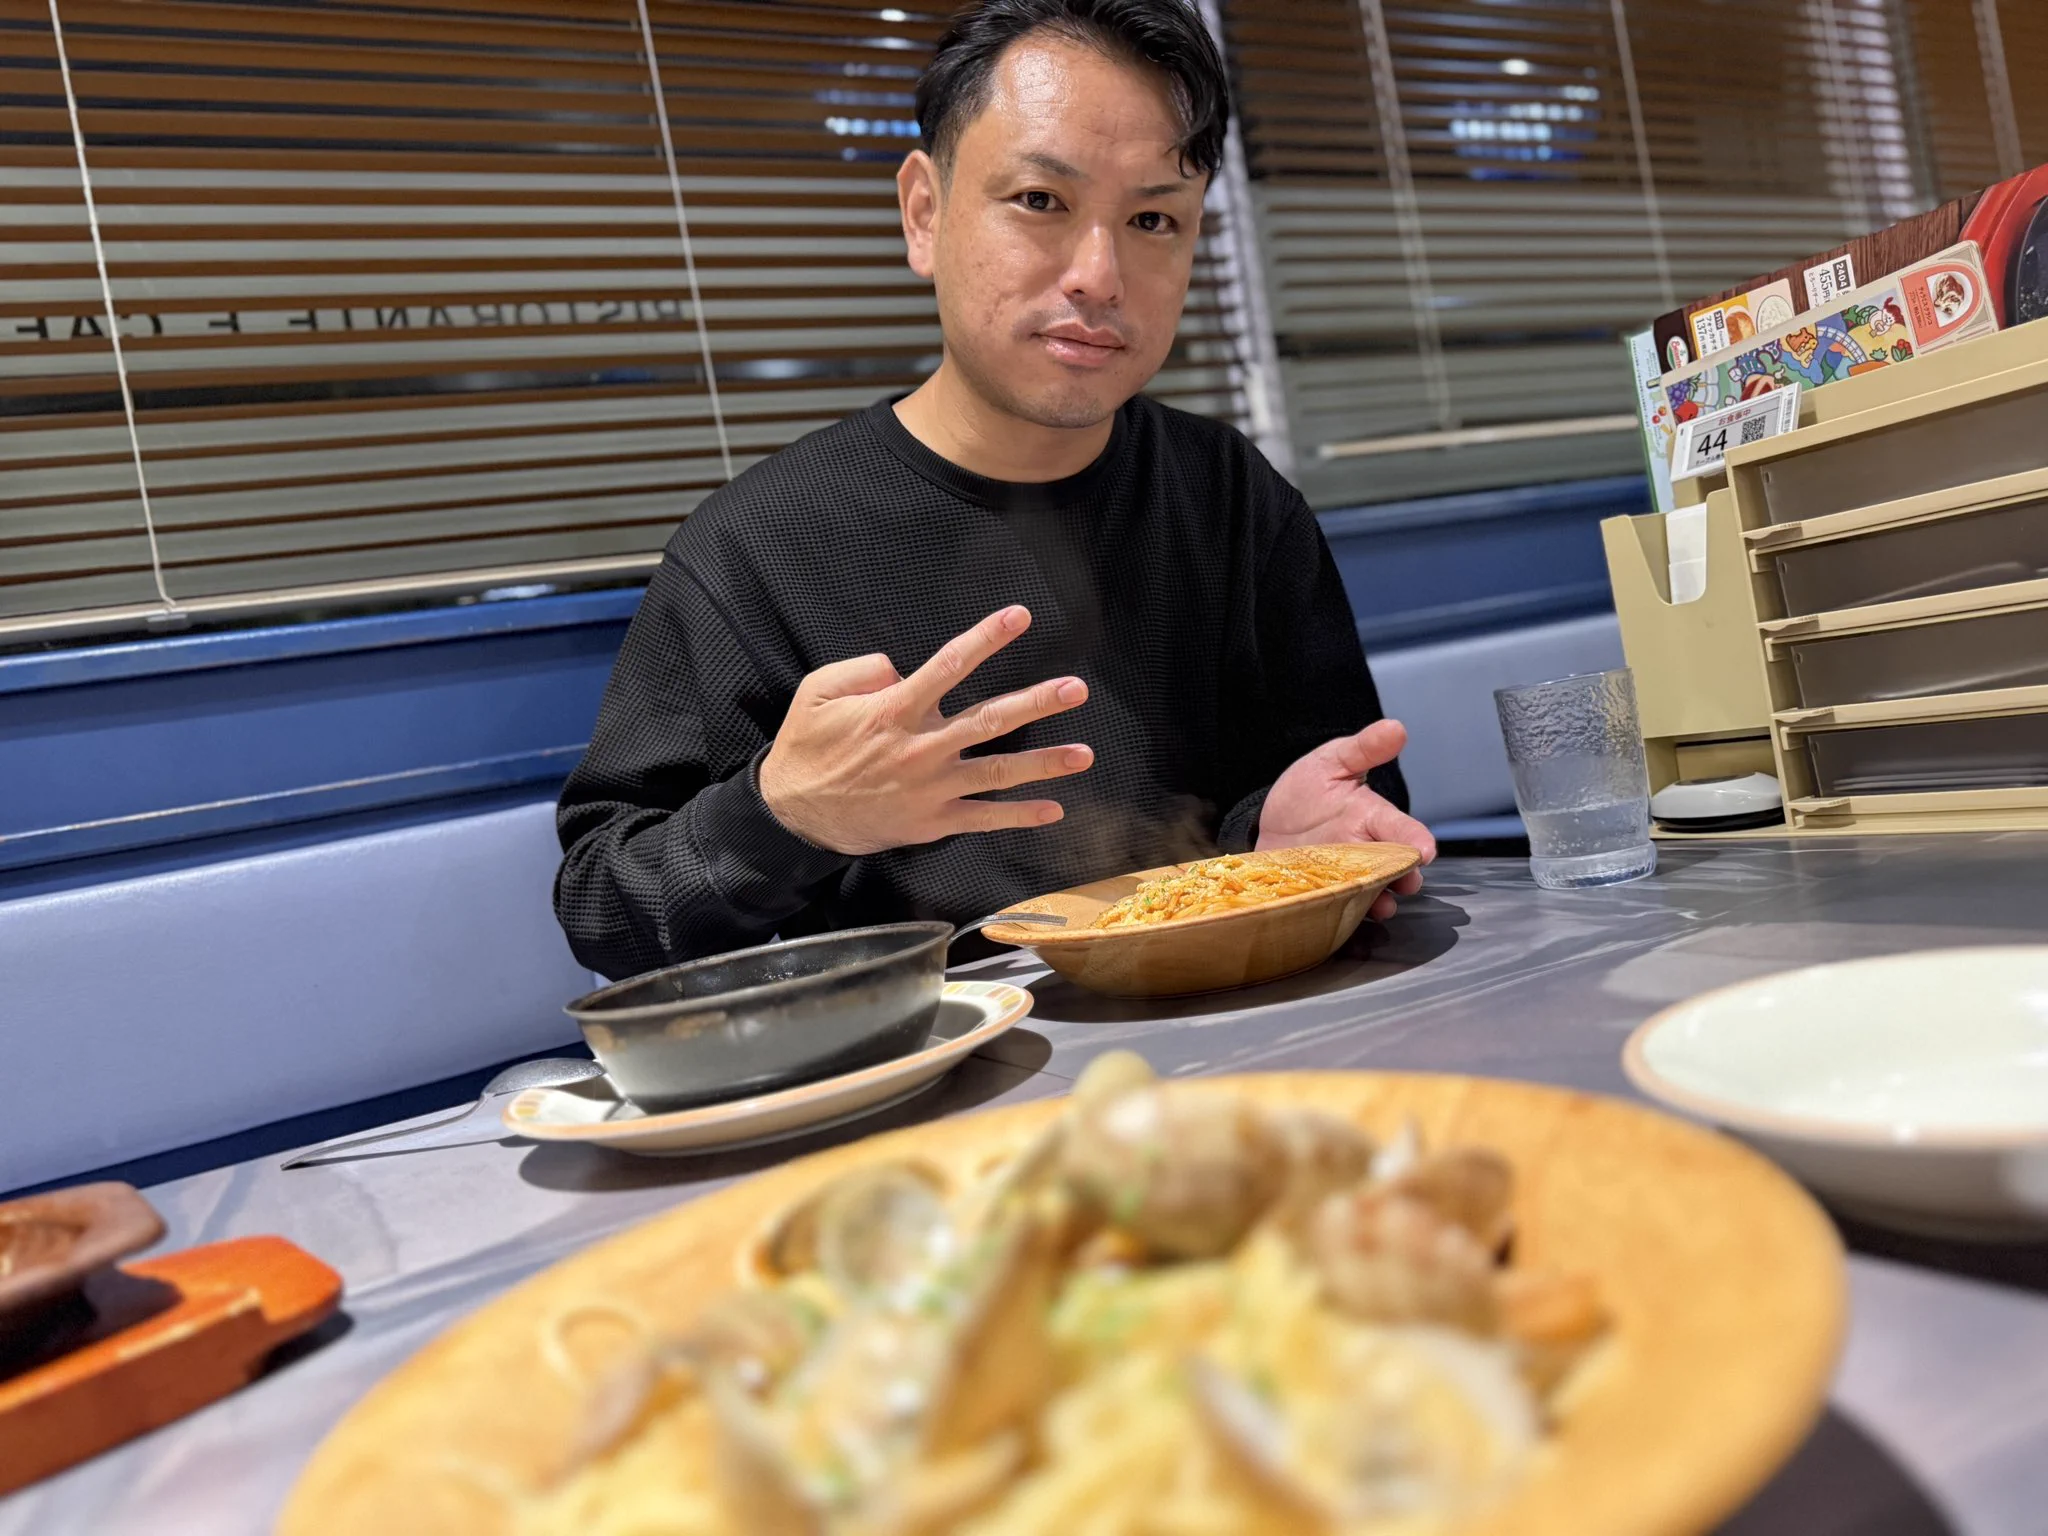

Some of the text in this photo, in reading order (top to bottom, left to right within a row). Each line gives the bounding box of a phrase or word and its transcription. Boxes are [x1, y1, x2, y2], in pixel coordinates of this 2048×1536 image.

[1836, 262, 1848, 288] 2404
[1718, 408, 1752, 426] お食事中
[1697, 428, 1728, 456] 44
